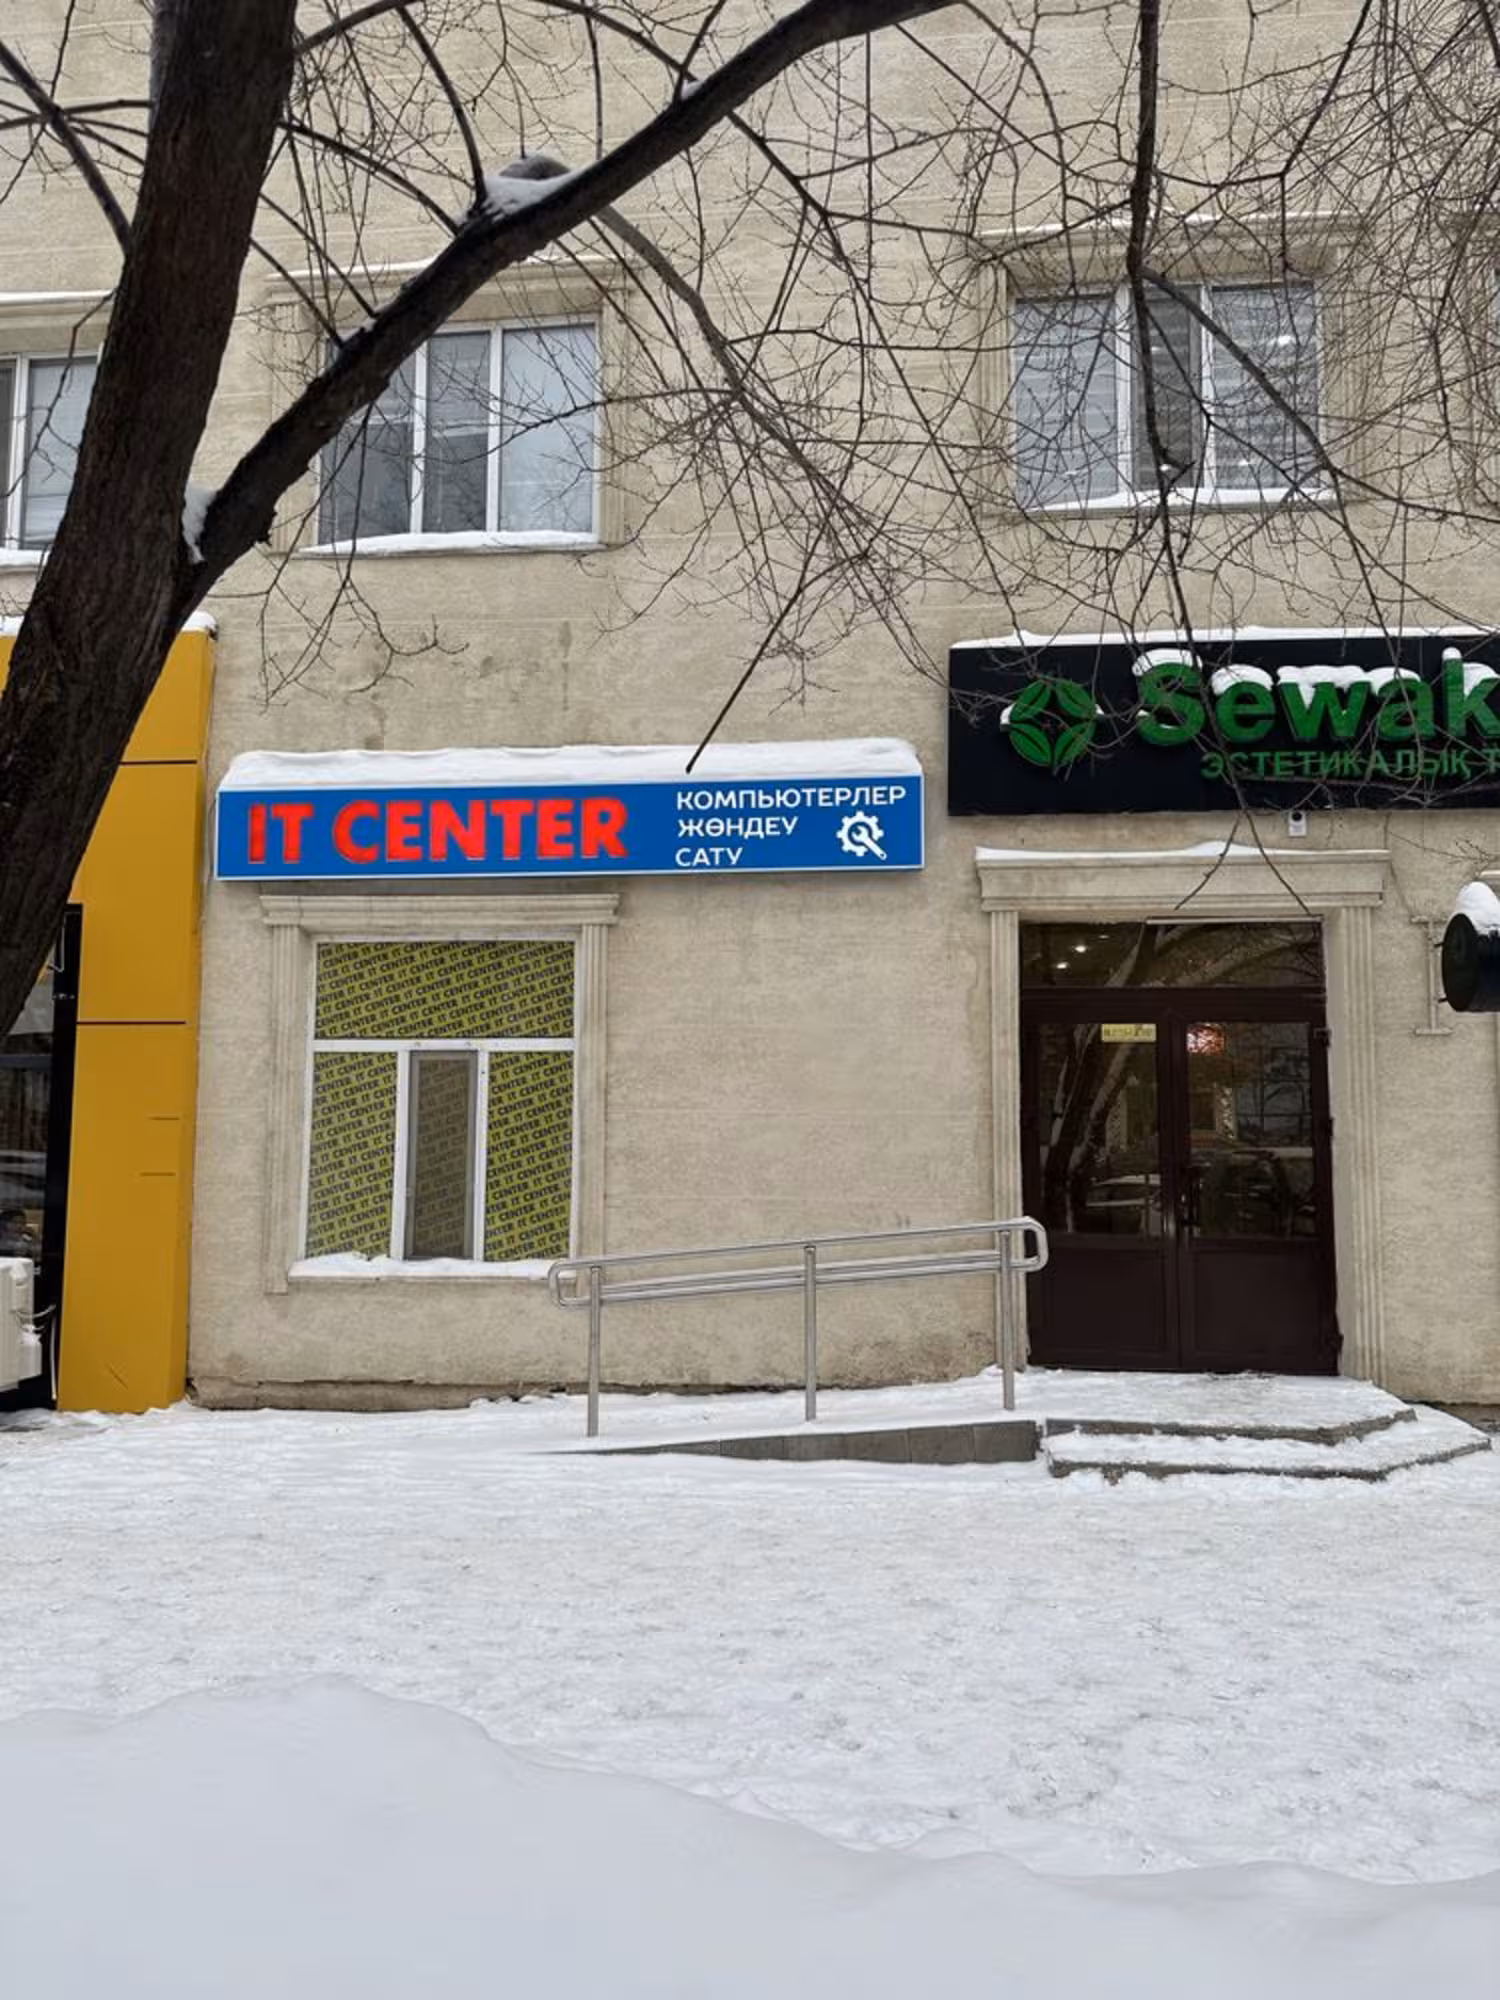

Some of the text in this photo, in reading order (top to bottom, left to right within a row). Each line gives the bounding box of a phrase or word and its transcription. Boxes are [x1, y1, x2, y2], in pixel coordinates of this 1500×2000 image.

[1136, 655, 1500, 745] Sewak
[677, 786, 907, 811] КОМПЬЮТЕРЛЕР
[248, 796, 629, 864] IT CENTER
[678, 816, 799, 840] ЖӨНДЕУ
[675, 847, 743, 867] САТУ
